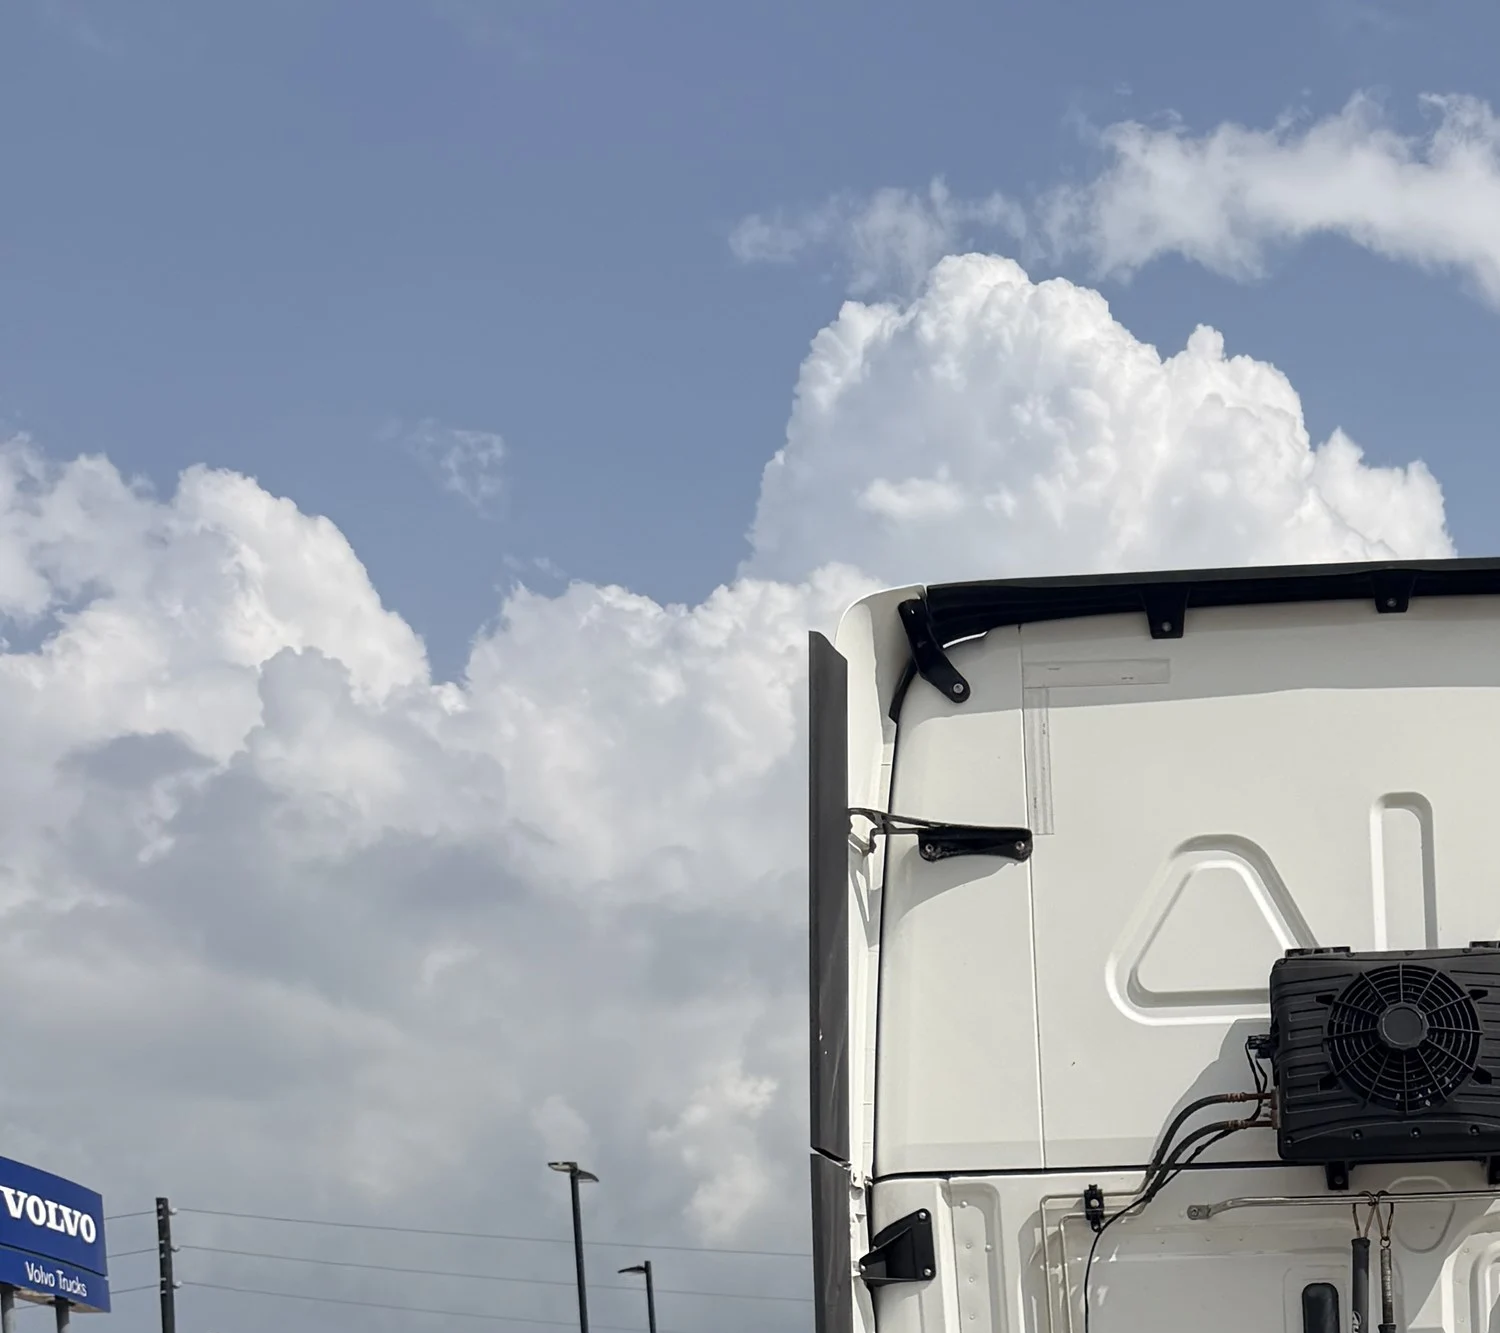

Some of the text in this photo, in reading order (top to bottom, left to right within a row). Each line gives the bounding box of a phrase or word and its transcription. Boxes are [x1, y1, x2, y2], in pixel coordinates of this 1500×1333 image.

[0, 1185, 97, 1244] VOLVO
[25, 1261, 87, 1297] Volvo Trucks
